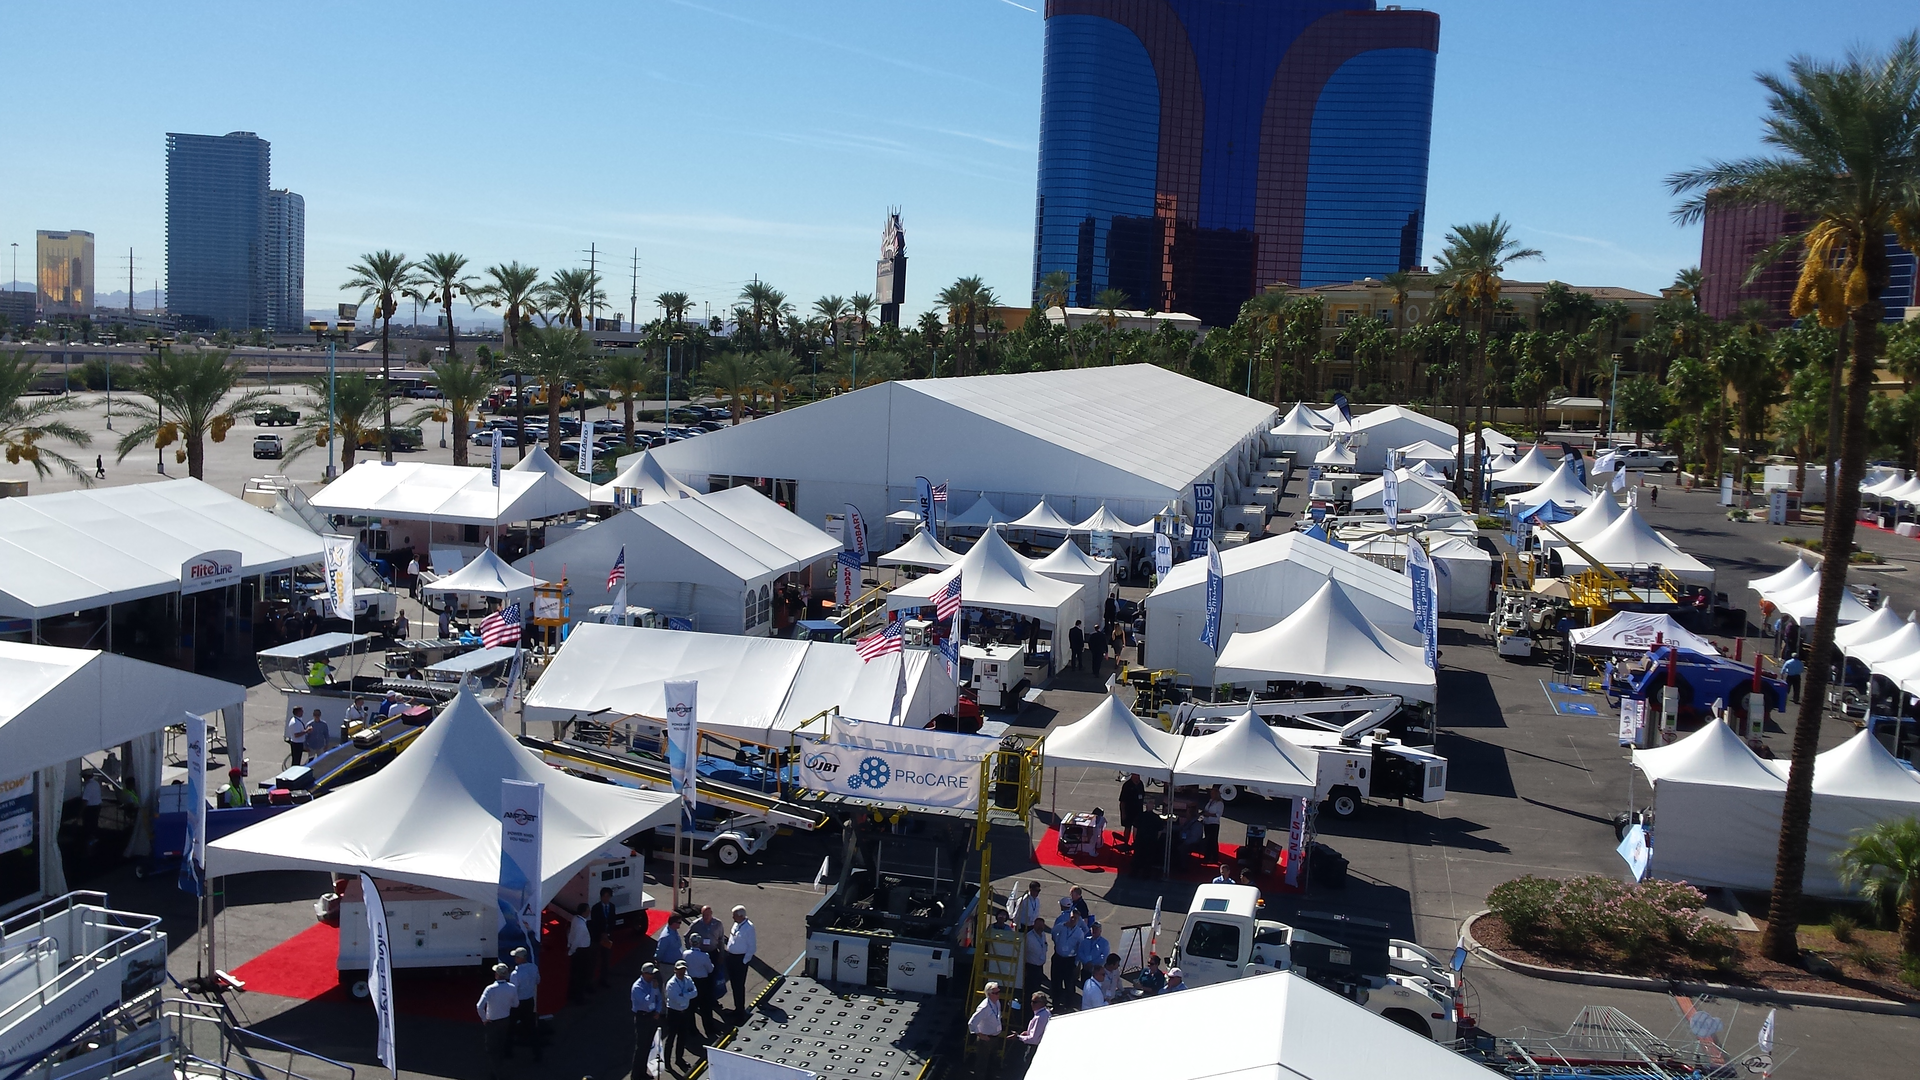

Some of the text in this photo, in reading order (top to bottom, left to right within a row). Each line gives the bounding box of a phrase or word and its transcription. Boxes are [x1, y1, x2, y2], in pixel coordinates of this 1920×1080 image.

[1195, 486, 1213, 497] TLD
[1197, 500, 1213, 511] TLD
[1197, 513, 1212, 525] TLD
[851, 513, 864, 549] HOBART
[1195, 527, 1211, 539] TLD
[815, 761, 840, 773] JBT
[1289, 811, 1300, 860] ISUZU
[8, 988, 99, 1055] www.aviramp.com
